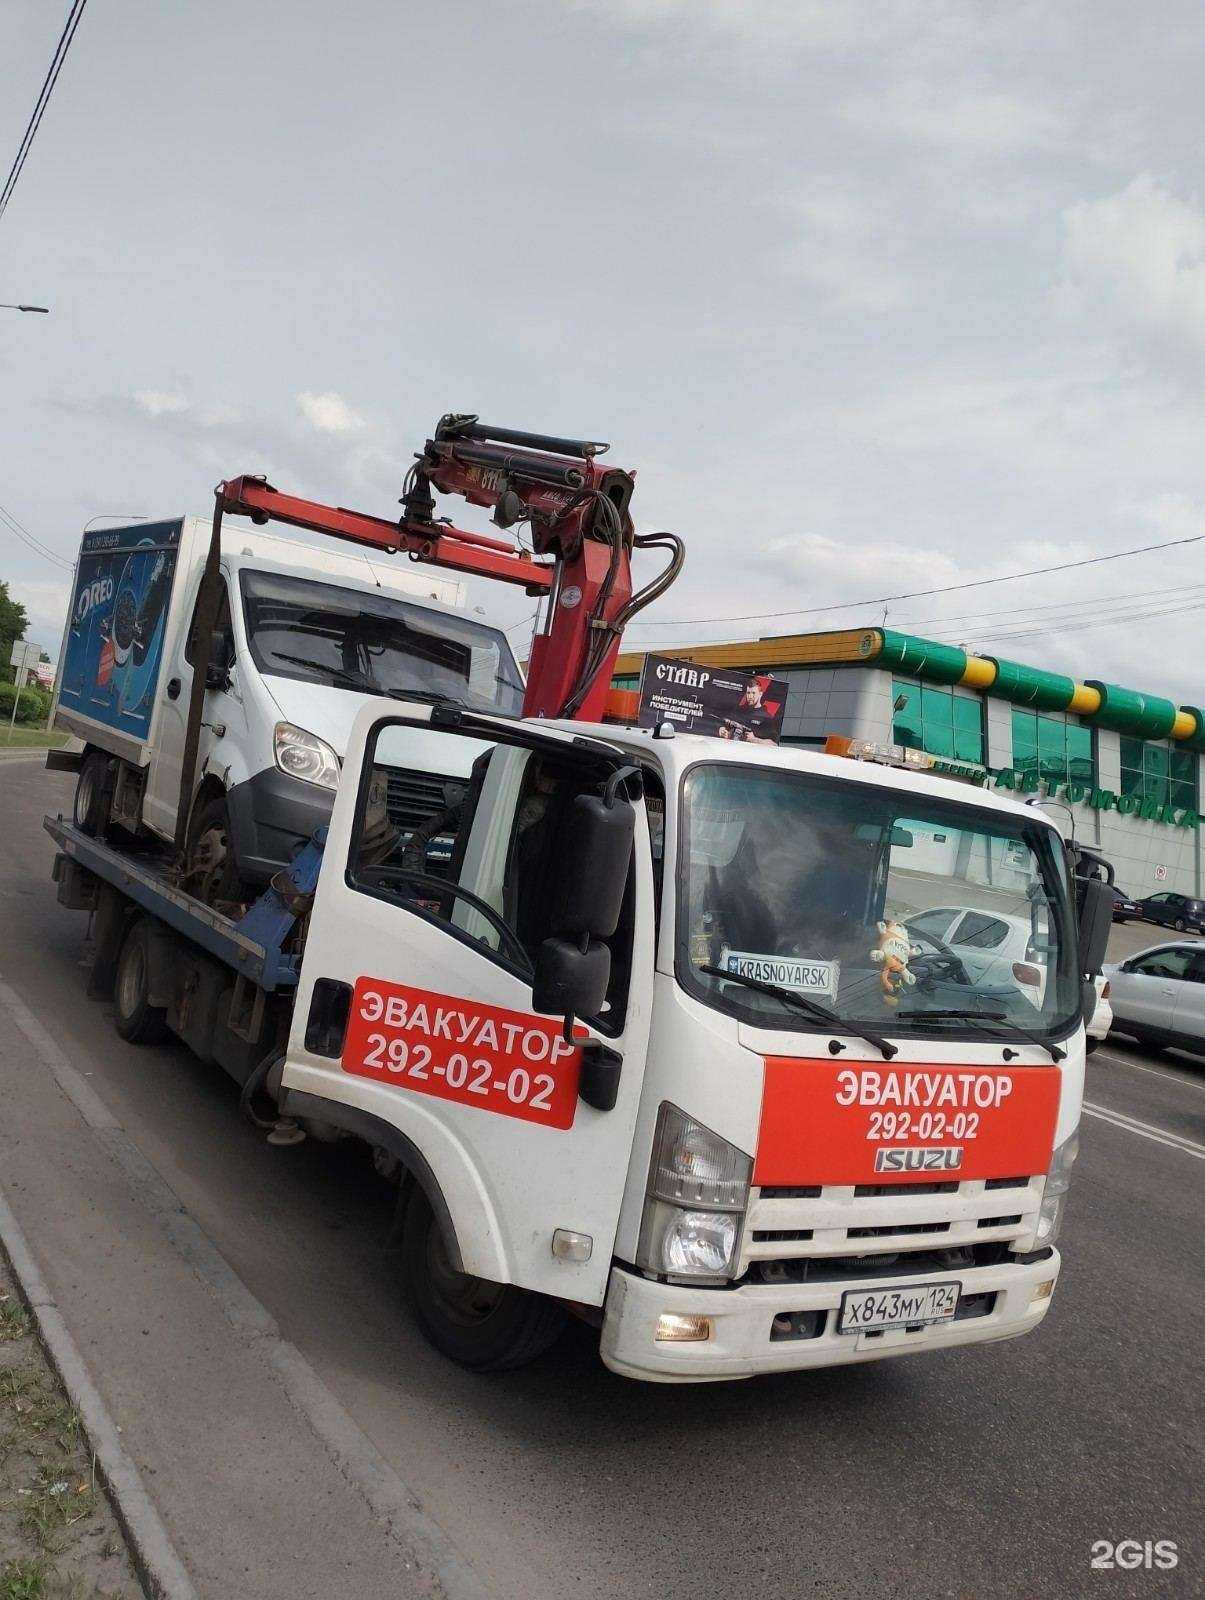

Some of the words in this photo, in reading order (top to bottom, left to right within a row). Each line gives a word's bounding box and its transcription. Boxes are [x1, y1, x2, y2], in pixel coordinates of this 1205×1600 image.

[78, 578, 113, 620] OREO
[656, 663, 710, 689] СТАВР
[649, 701, 704, 717] ПОБЕДИТЕЛЕЙ
[652, 694, 704, 710] ИНСТРУМЕНТ
[996, 770, 1200, 828] АВТОМОЙКА
[739, 960, 826, 986] KRASNOYARSK
[360, 991, 575, 1065] ЭВАКУАТОР
[363, 1033, 555, 1111] 292-02-02
[835, 1070, 1013, 1108] ЭВАКУАТОР
[866, 1111, 980, 1140] 292-02-02
[875, 1148, 963, 1172] ISUZU
[929, 1287, 954, 1308] 124
